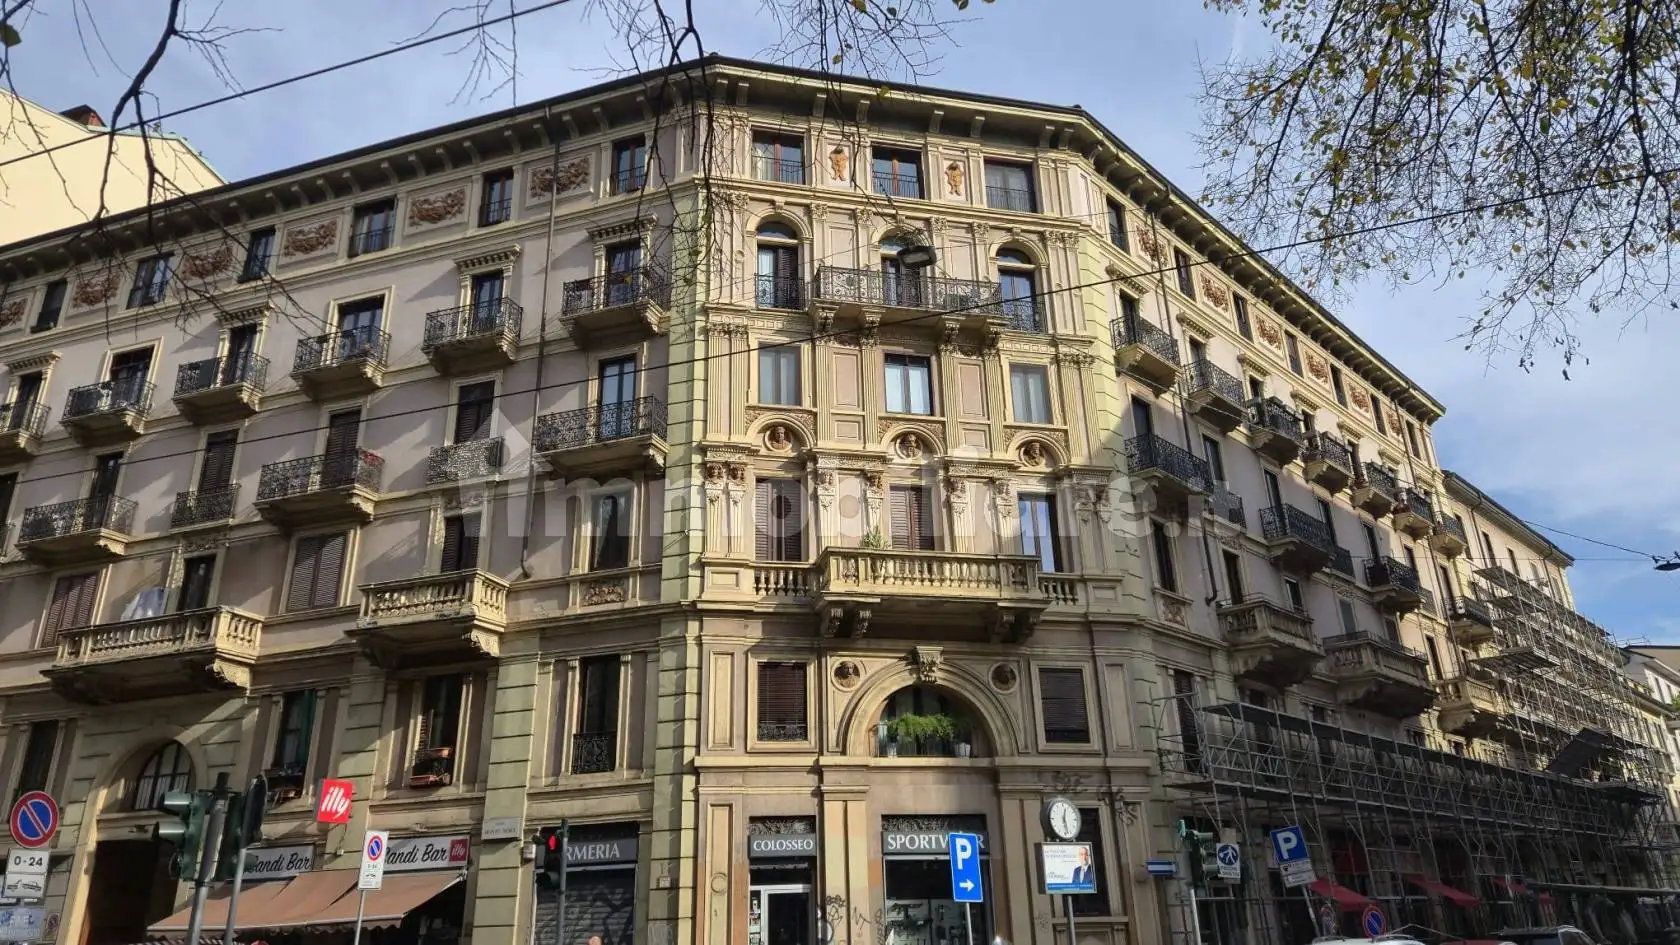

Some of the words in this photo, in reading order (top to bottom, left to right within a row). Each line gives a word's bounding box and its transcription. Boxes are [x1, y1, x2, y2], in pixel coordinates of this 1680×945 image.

[321, 786, 350, 819] illy
[565, 842, 621, 861] RMERIA
[753, 838, 814, 851] COLOSSEO
[887, 834, 985, 850] SPORTWR
[1276, 831, 1298, 860] P
[286, 852, 310, 871] Bar
[421, 843, 448, 862] Bar
[955, 837, 972, 870] P
